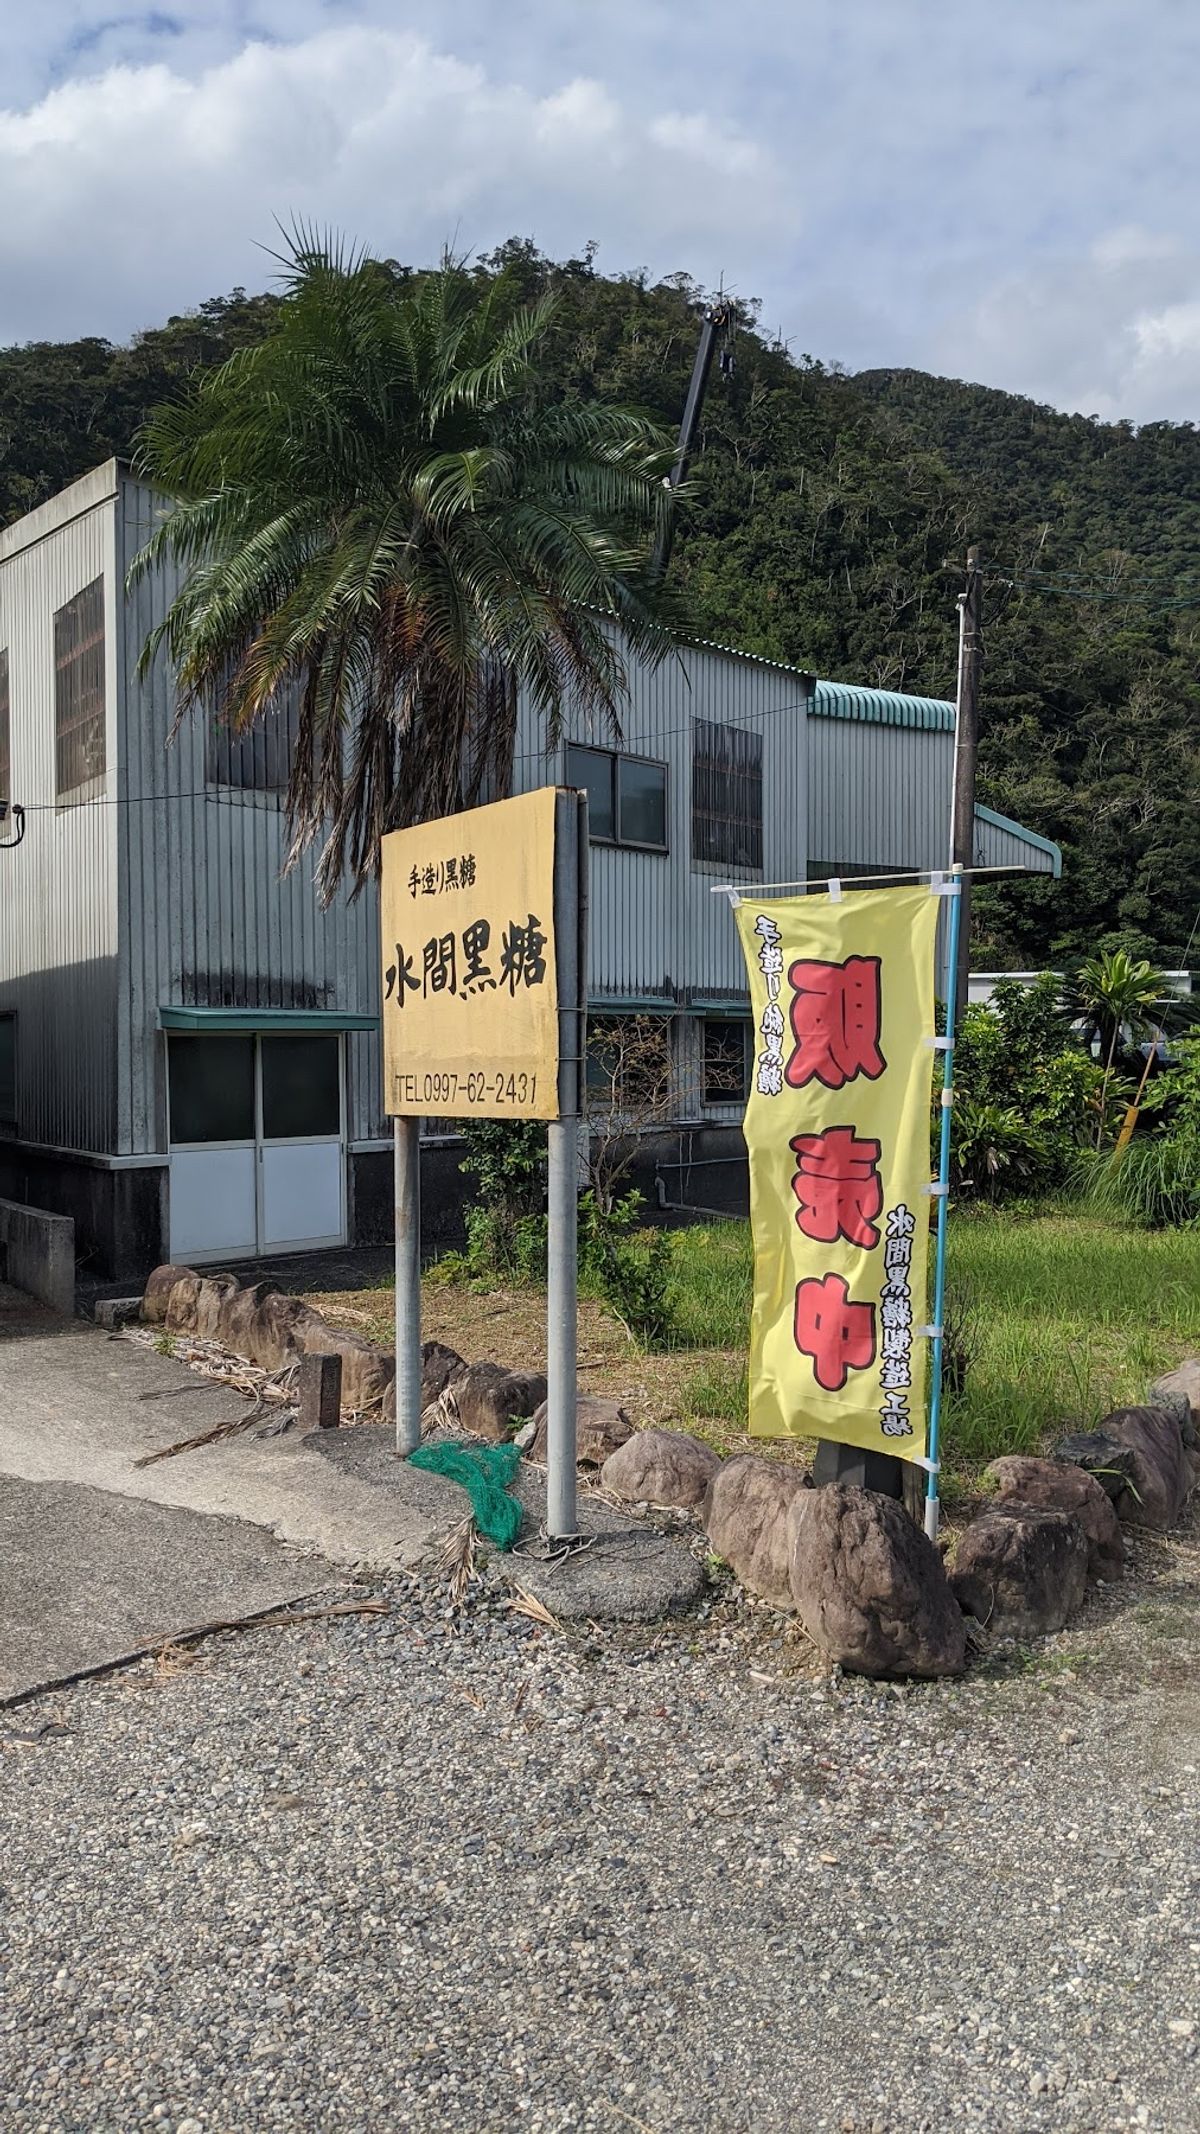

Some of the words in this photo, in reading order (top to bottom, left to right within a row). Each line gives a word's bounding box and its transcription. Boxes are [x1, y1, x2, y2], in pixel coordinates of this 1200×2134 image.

[407, 854, 476, 898] 手造り黒糖
[385, 914, 547, 1008] 水間黒糖
[395, 1072, 537, 1104] TEL0997-62-2431
